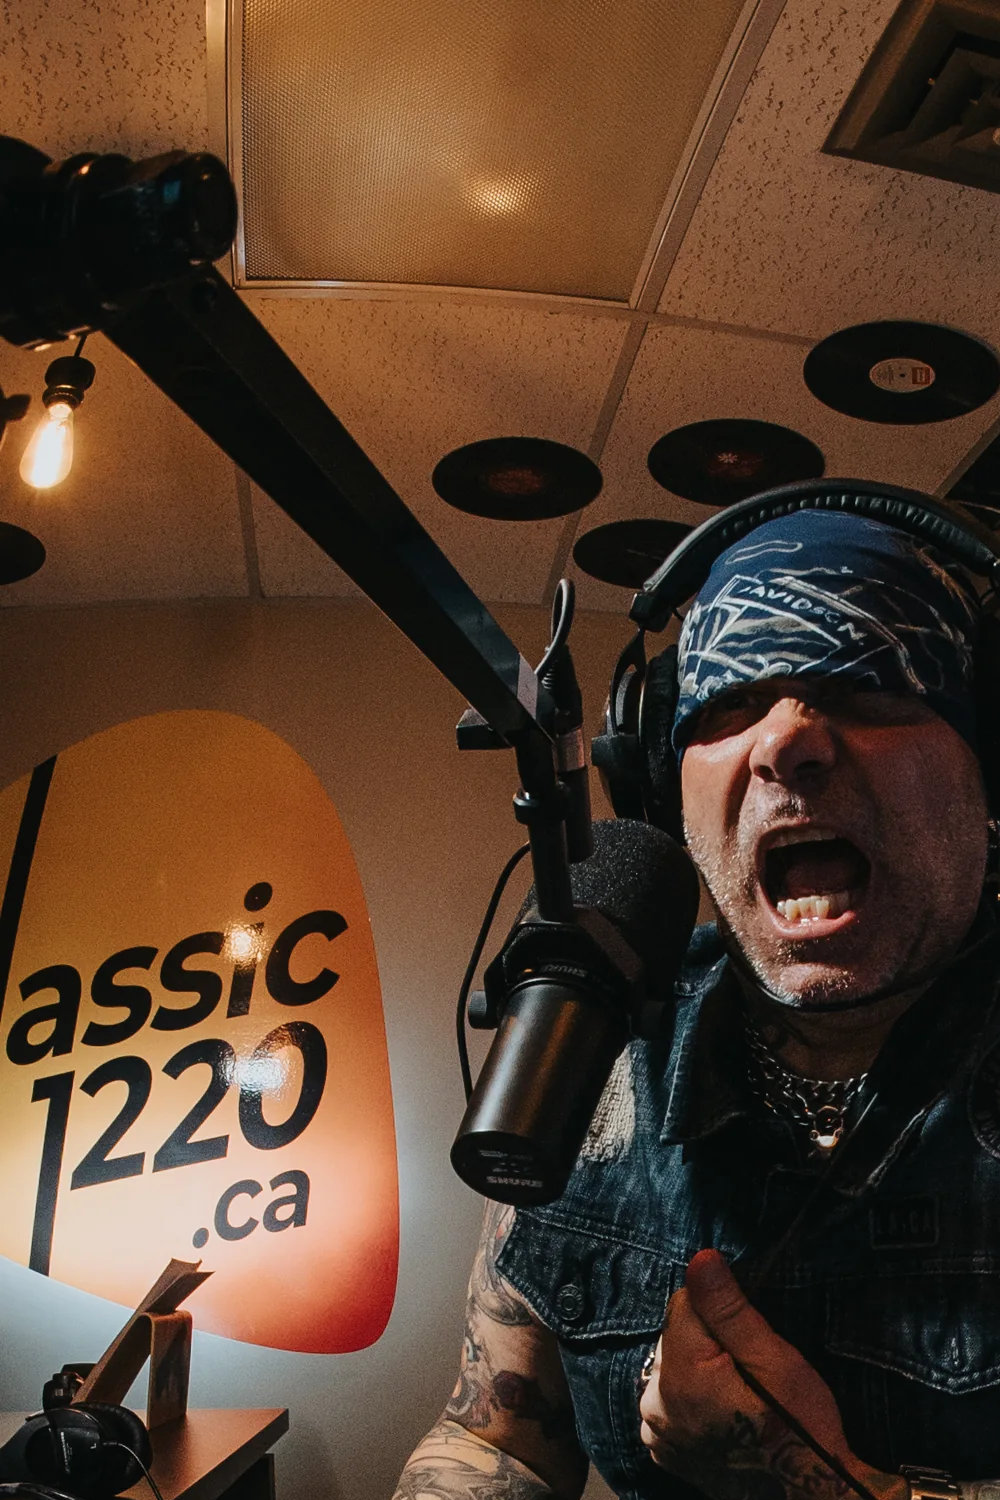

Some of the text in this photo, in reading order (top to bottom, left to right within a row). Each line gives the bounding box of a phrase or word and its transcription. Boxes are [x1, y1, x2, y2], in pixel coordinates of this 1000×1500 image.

[738, 585, 868, 641] AVIDSON
[28, 1020, 328, 1276] 1220
[191, 1168, 312, 1249] .ca
